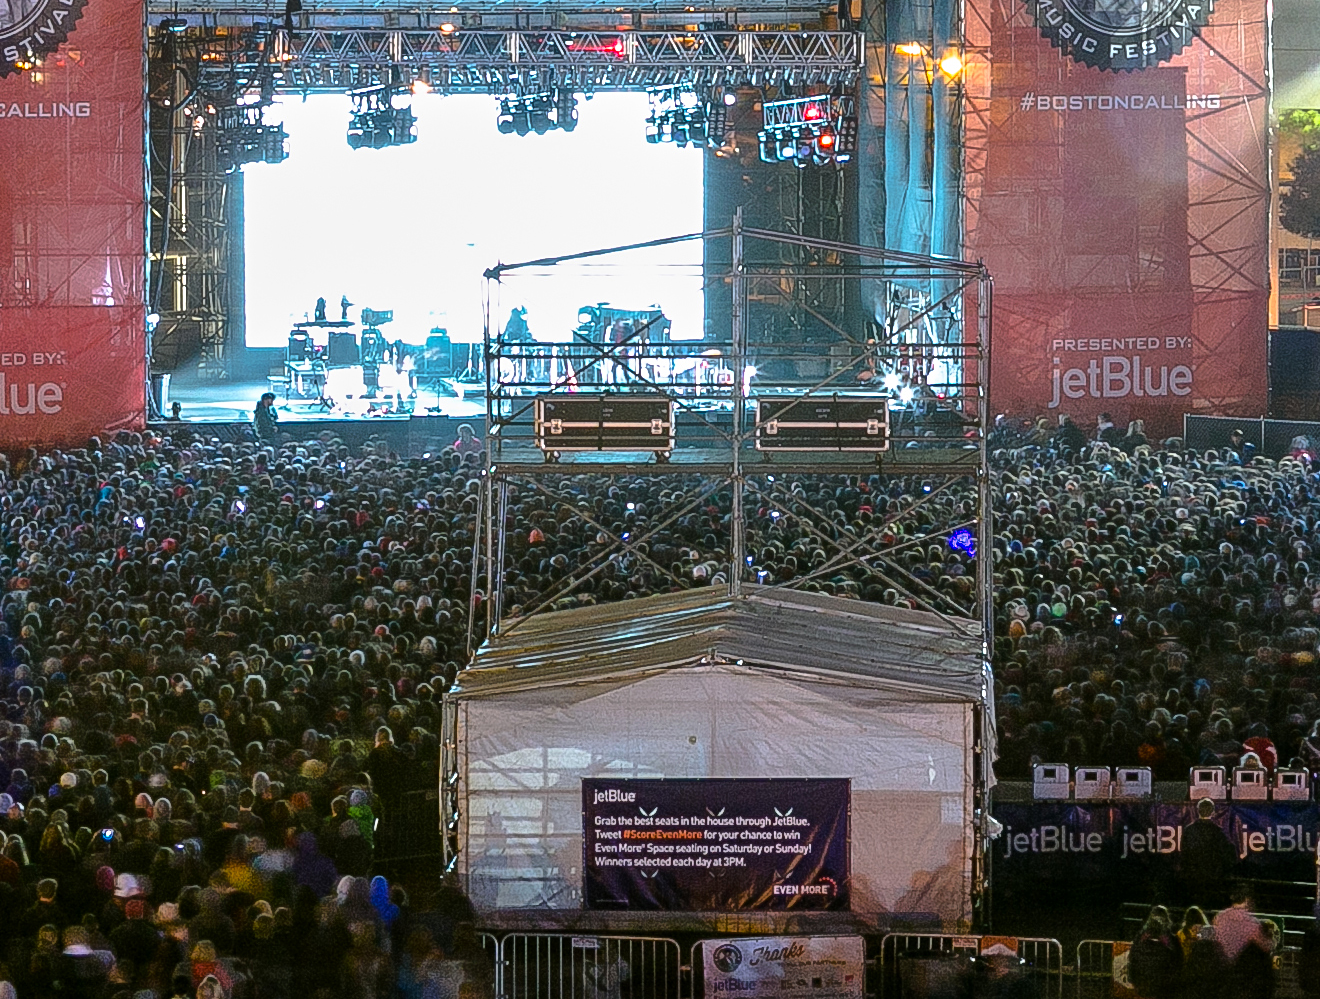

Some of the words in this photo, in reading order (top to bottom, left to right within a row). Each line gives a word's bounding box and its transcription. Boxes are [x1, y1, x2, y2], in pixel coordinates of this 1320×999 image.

[1020, 92, 1221, 112] #BOSTONCALLING
[1052, 337, 1160, 351] PRESENTED
[1165, 336, 1192, 349] BY:
[33, 352, 62, 365] BY:
[1048, 355, 1193, 409] jetBlue
[593, 789, 636, 804] jetBlue
[595, 816, 616, 827] Grab
[618, 816, 633, 827] the
[635, 816, 653, 827] best
[655, 816, 679, 827] seats
[681, 816, 689, 827] in
[691, 816, 705, 827] the
[707, 816, 734, 827] house
[736, 816, 771, 827] through
[773, 816, 810, 827] JetBlue.
[595, 830, 622, 839] Tweet
[623, 830, 702, 839] #ScoreEvenMore
[704, 830, 717, 839] for
[719, 830, 738, 839] your
[740, 830, 771, 839] chance
[774, 830, 783, 839] to
[784, 830, 800, 839] win
[1004, 825, 1103, 859] jetBlue
[1121, 825, 1182, 859] jetBl
[1239, 824, 1318, 860] jetBlu
[595, 844, 617, 855] Even
[647, 844, 674, 855] Space
[676, 844, 708, 855] seating
[710, 844, 721, 855] on
[723, 844, 762, 855] Saturday
[764, 844, 774, 855] or
[776, 844, 811, 855] Sunday!
[595, 857, 632, 868] Winners
[634, 857, 671, 868] selected
[673, 857, 693, 868] each
[695, 857, 711, 868] day
[713, 857, 722, 868] at
[724, 857, 746, 868] 3PM.
[774, 885, 799, 894] EVEN
[801, 885, 828, 894] MORE
[749, 941, 805, 966] Thanks
[713, 978, 757, 994] jetBlue
